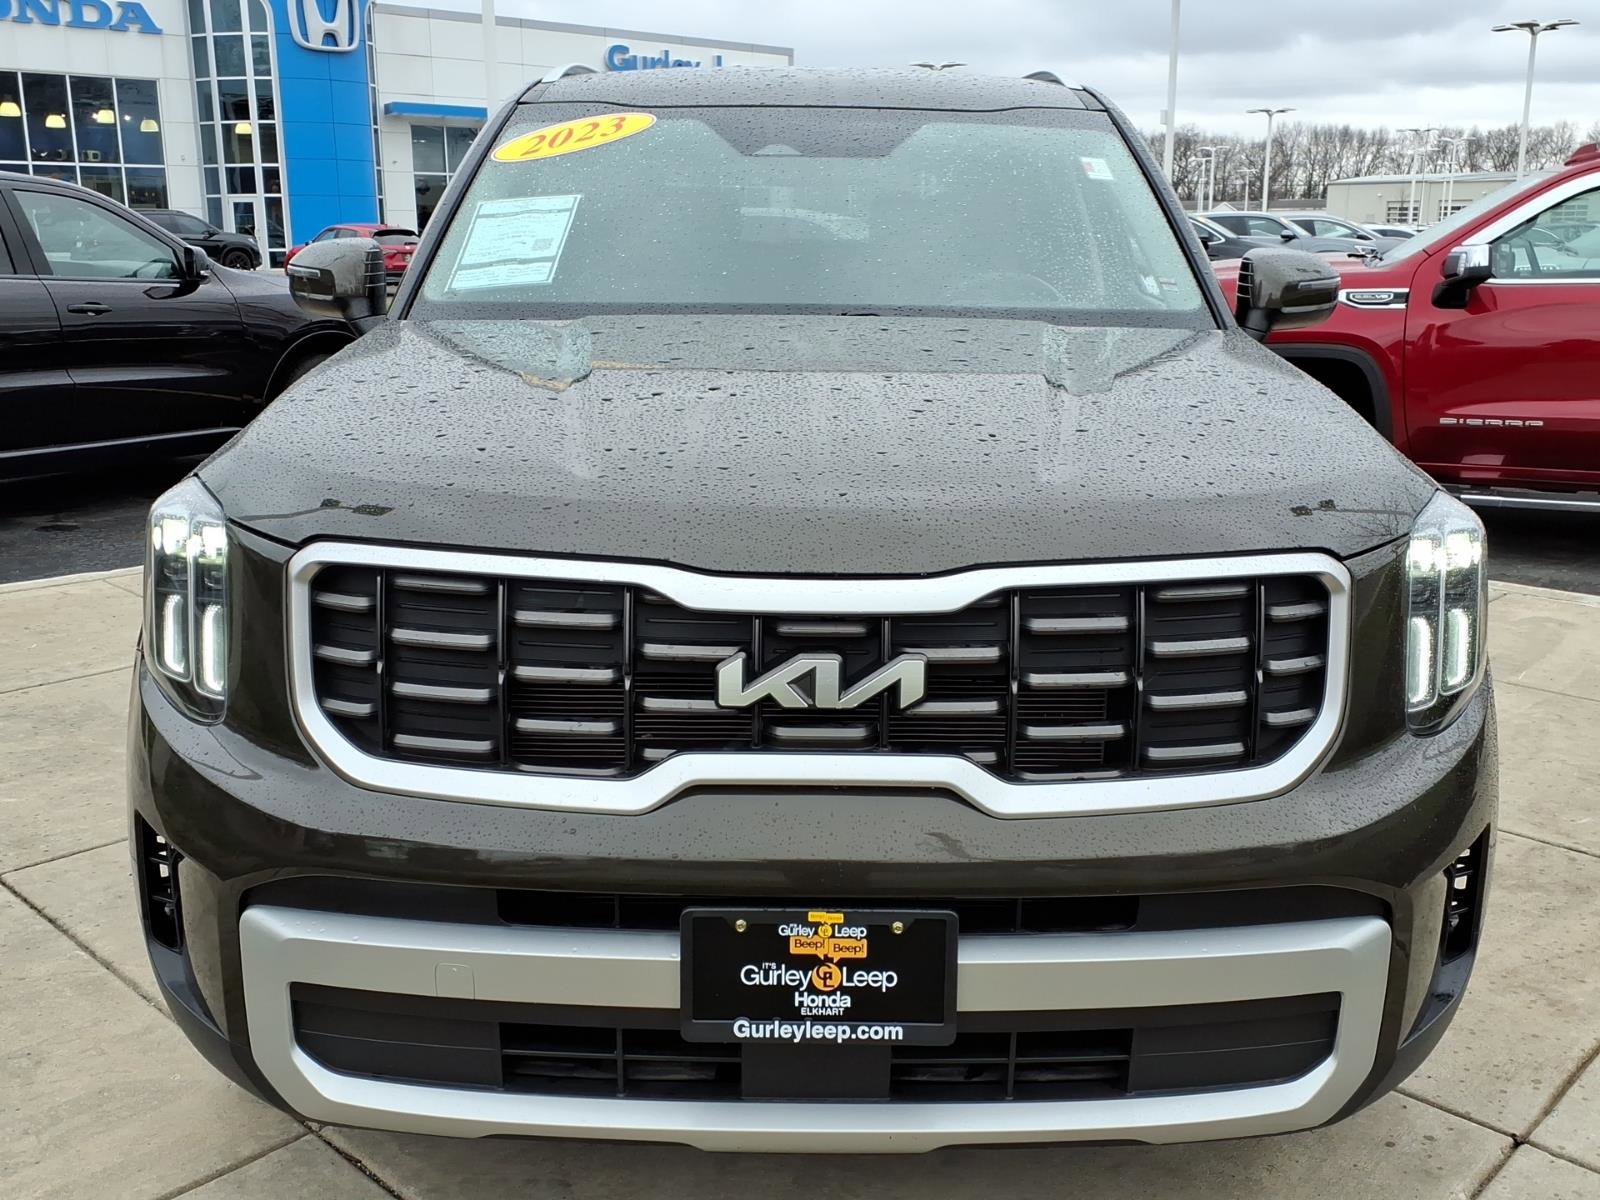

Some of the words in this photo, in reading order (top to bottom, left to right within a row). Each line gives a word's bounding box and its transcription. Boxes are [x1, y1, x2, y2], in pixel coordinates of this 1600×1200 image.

[0, 0, 163, 34] NDA
[519, 116, 627, 157] 2023
[1439, 417, 1544, 427] SIERRA
[716, 651, 928, 709] KIA
[834, 924, 867, 940] Leep
[794, 938, 825, 951] Beep!
[833, 943, 864, 955] Beep!
[740, 964, 812, 991] Gurley
[842, 966, 898, 992] Leep
[794, 991, 851, 1008] Honda
[800, 1007, 845, 1016] ELKHART
[733, 1018, 904, 1044] Gurleyleep.com
